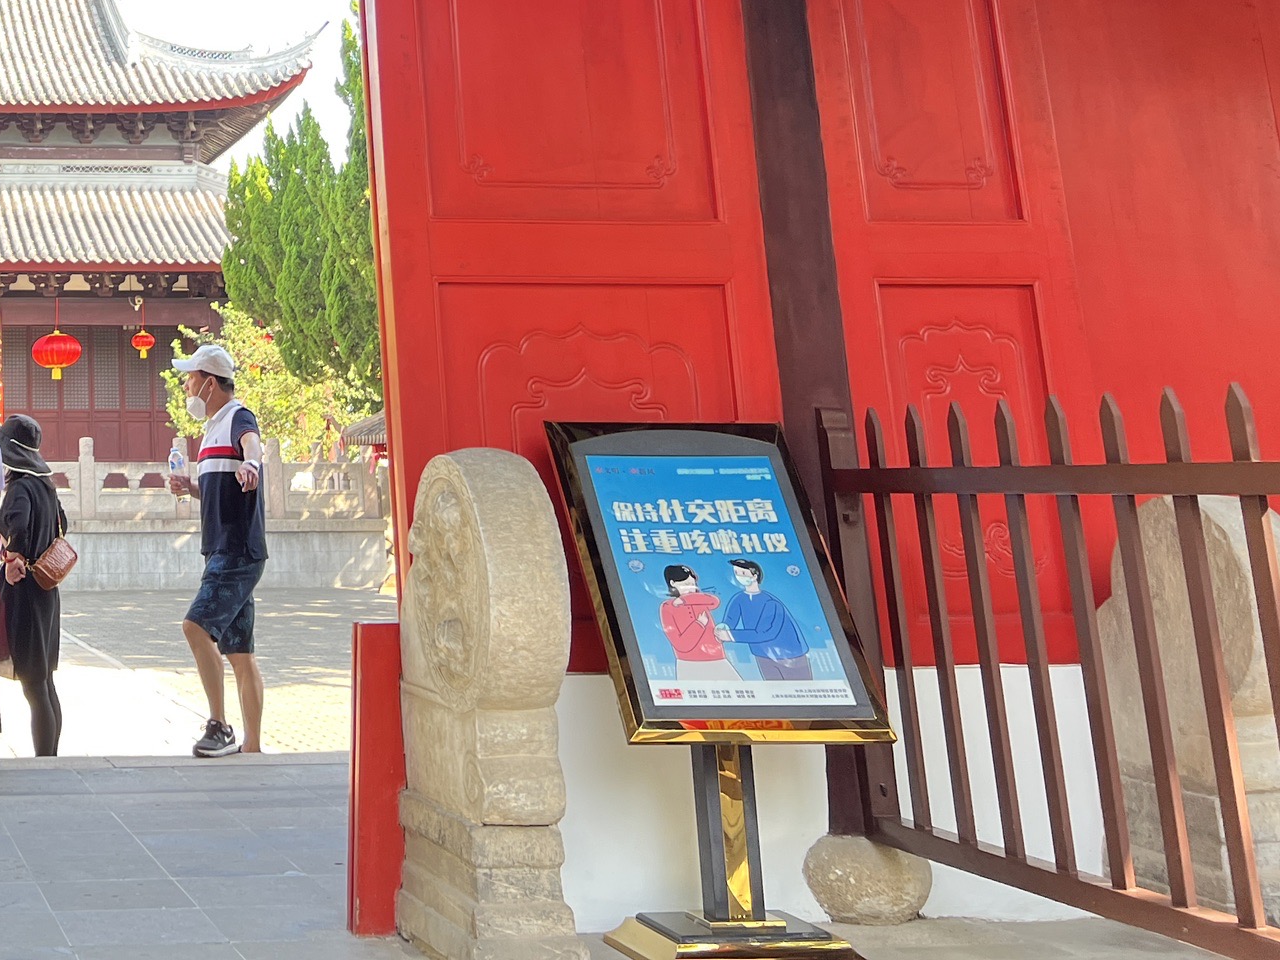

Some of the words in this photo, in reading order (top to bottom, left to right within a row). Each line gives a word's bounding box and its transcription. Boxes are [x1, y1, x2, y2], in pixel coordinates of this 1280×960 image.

[612, 499, 778, 524] 保持社交距离
[619, 528, 790, 555] 注重咳嗽礼仪
